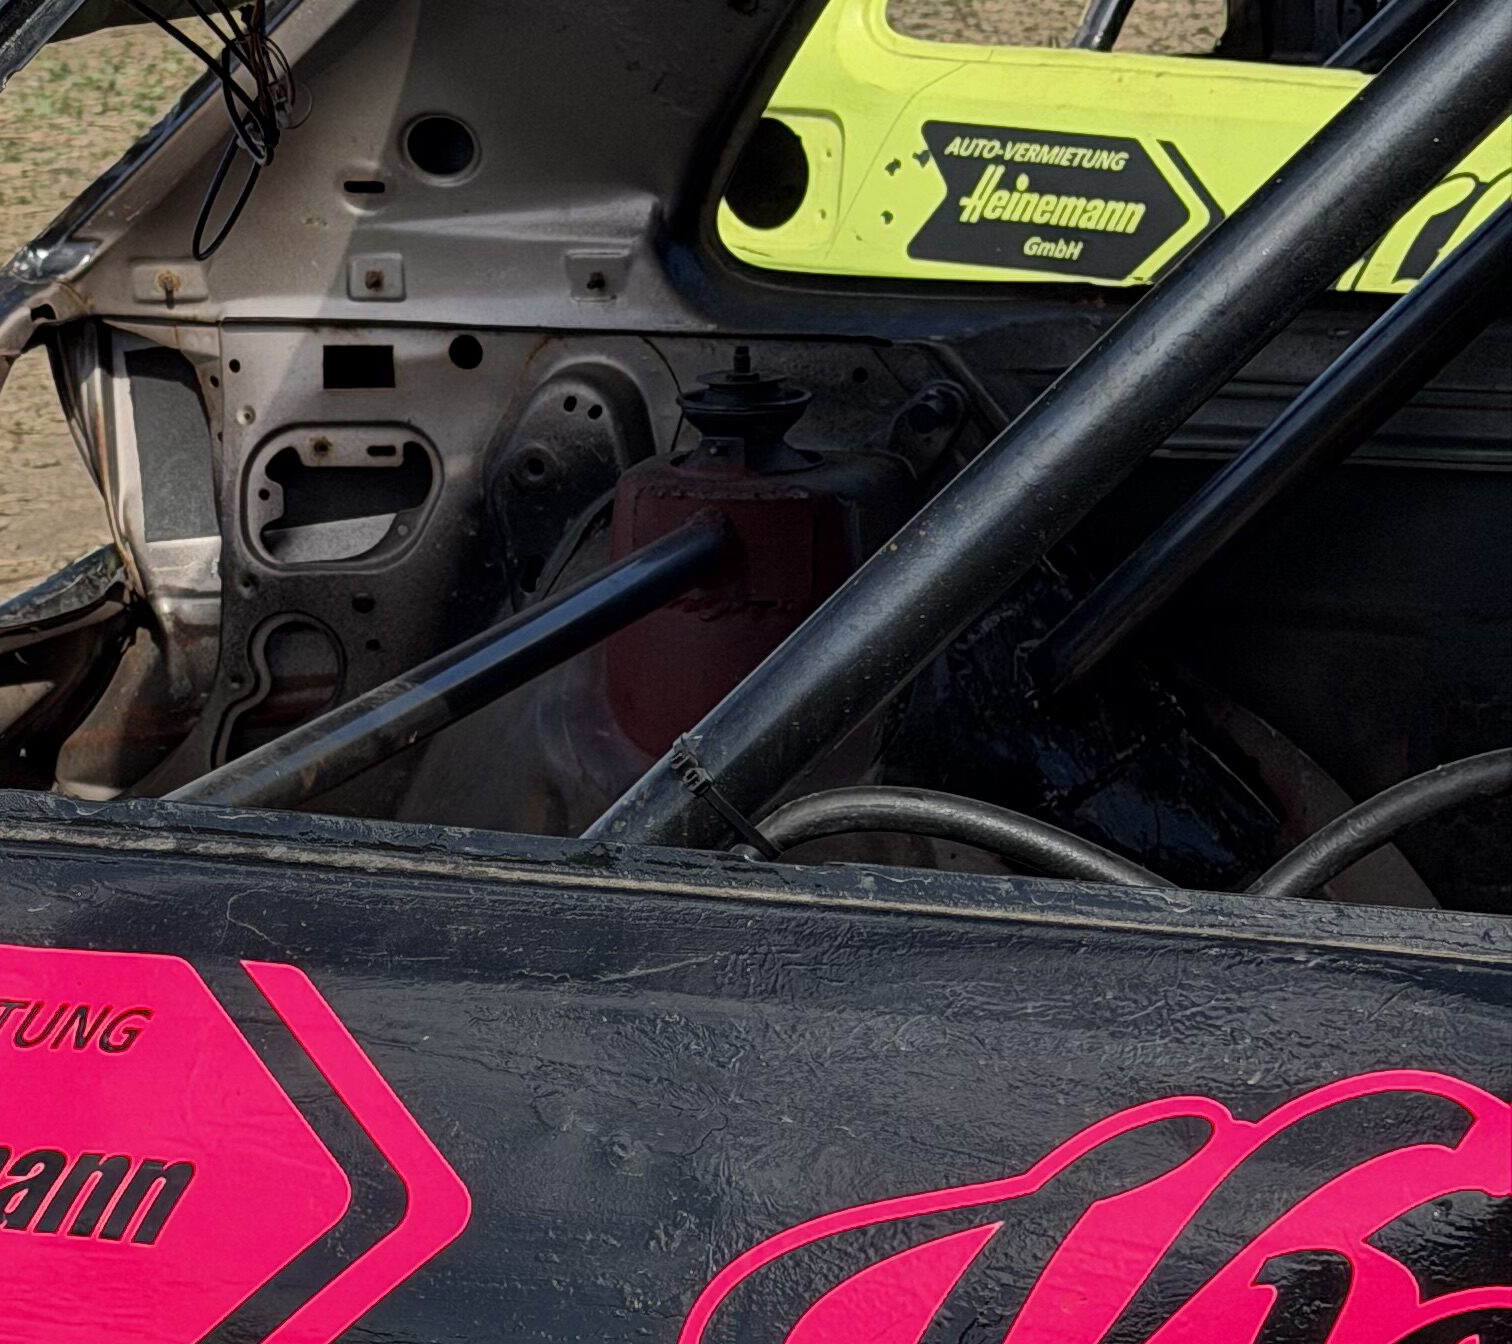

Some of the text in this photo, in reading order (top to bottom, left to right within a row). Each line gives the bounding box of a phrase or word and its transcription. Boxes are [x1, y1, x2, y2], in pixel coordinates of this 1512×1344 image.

[944, 136, 1130, 172] AUTO-VERMIETUNG
[958, 163, 1147, 235] Heinemann
[1023, 236, 1085, 262] GmbH
